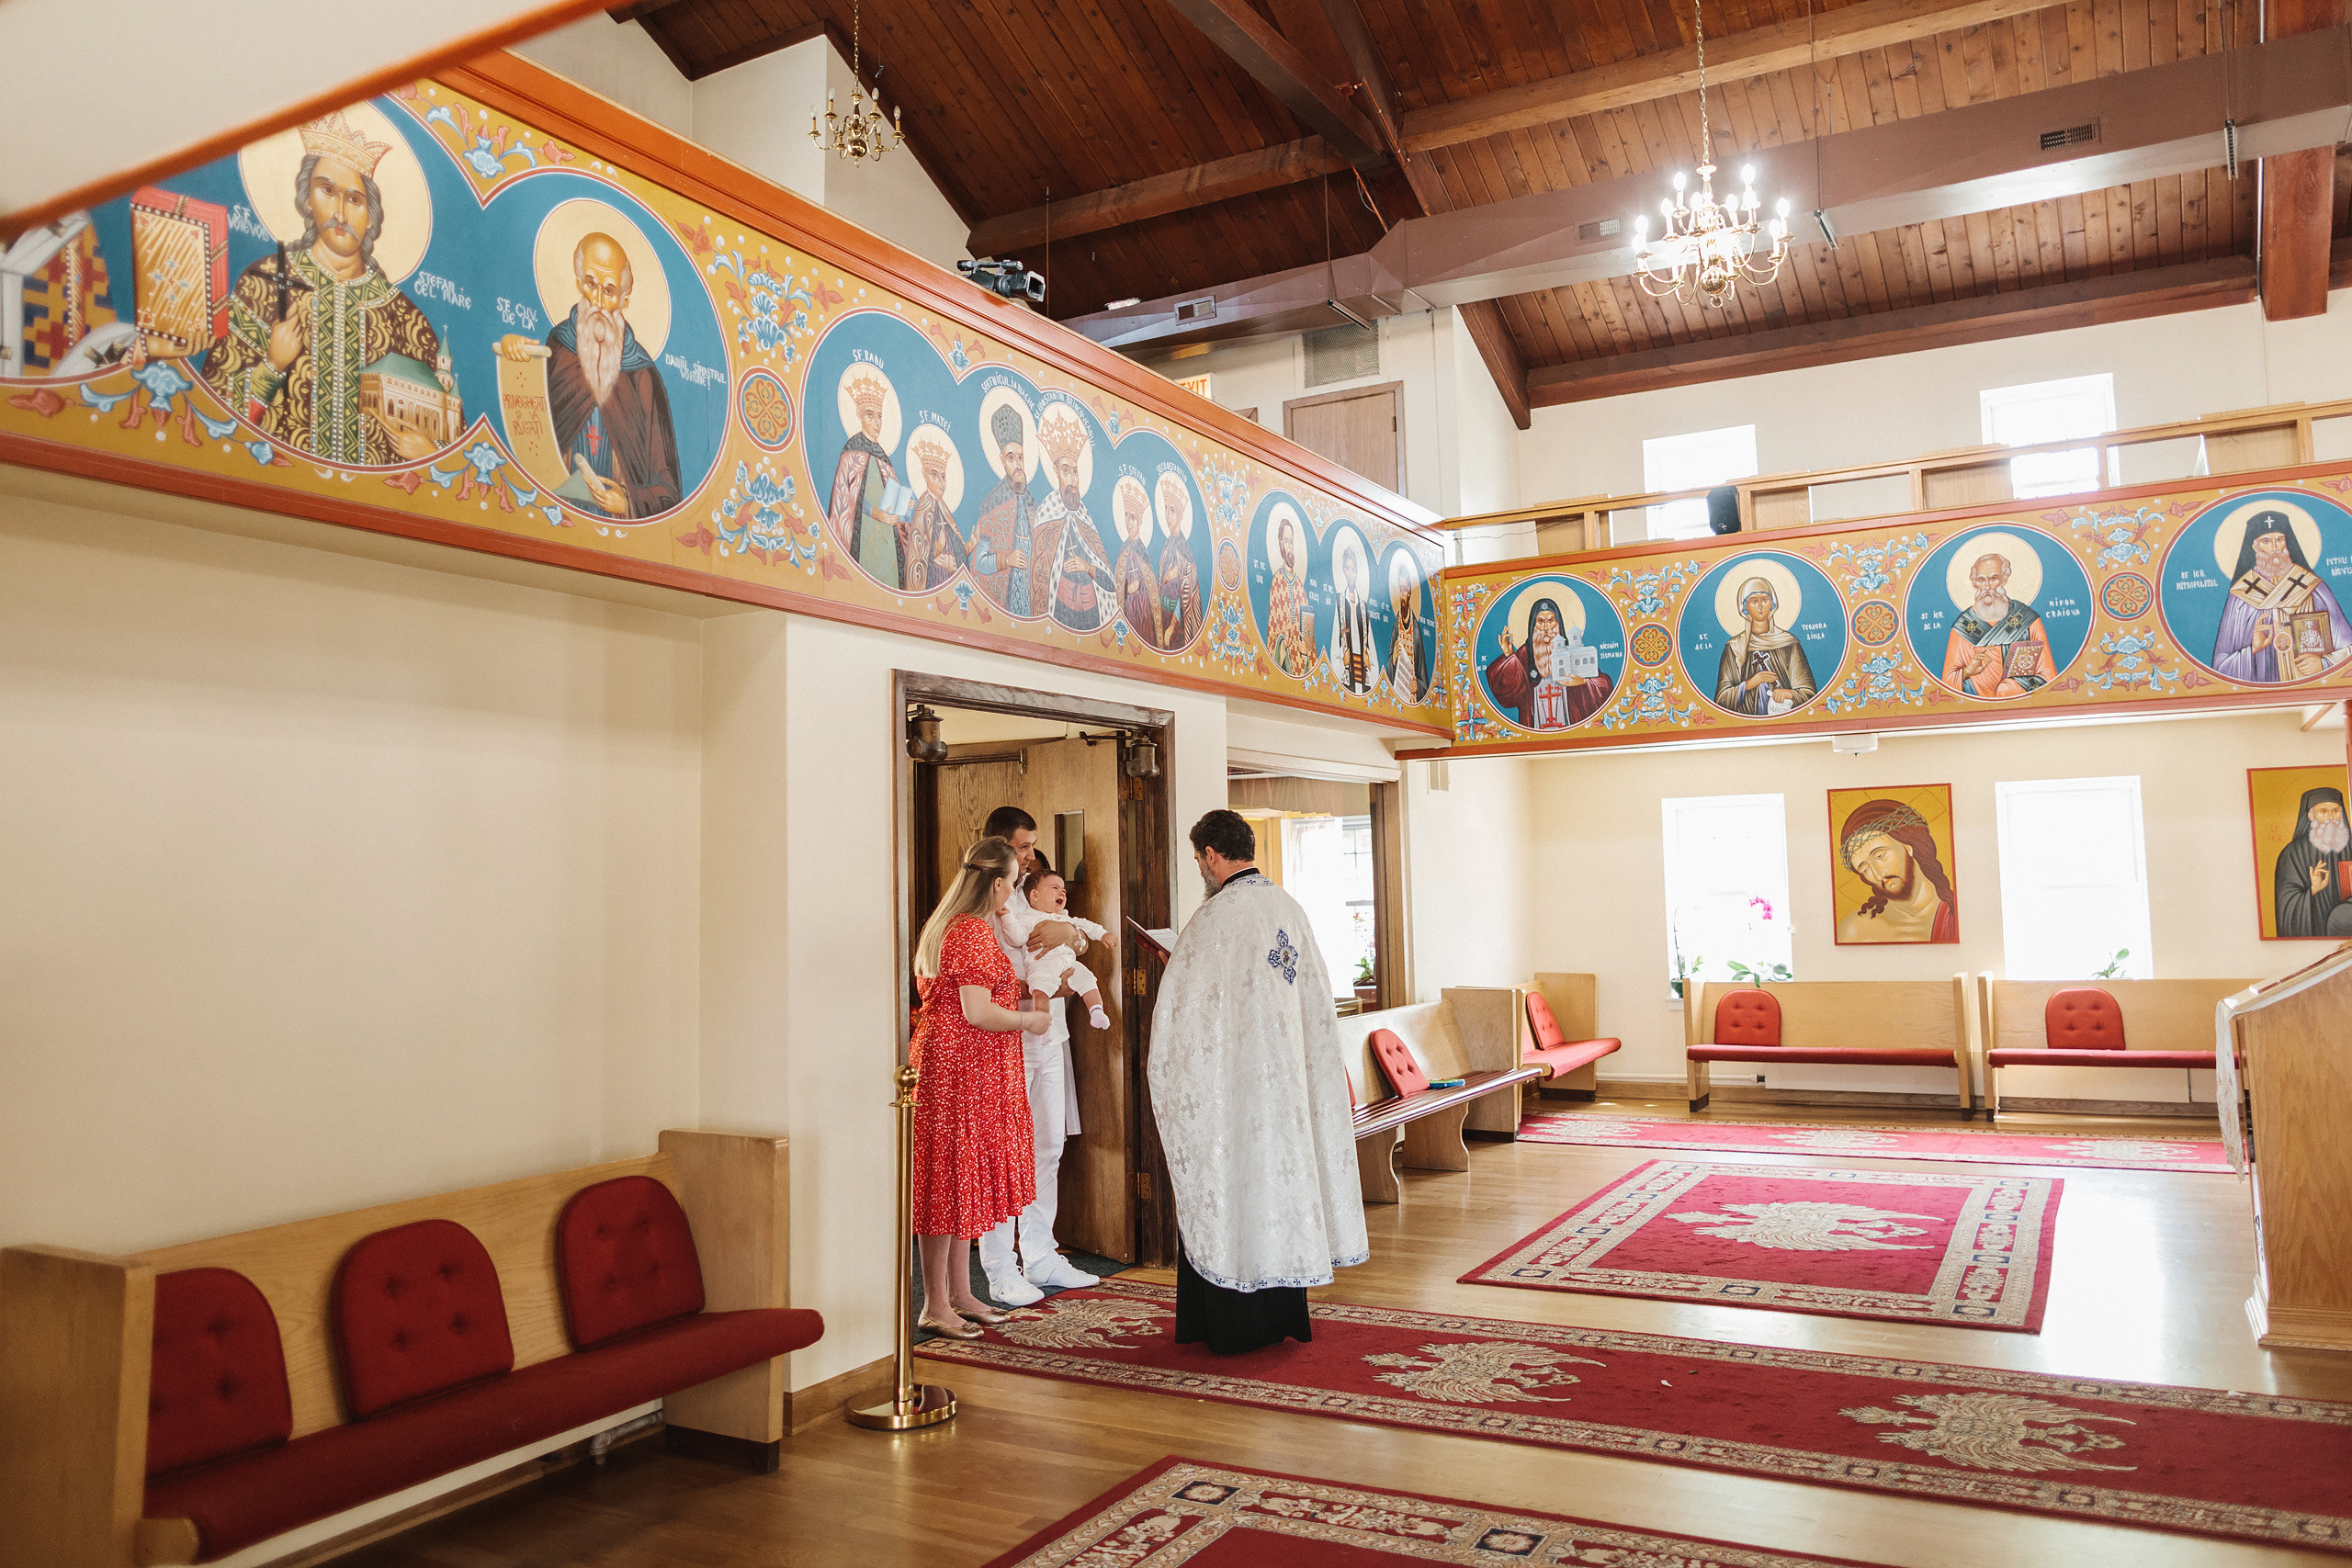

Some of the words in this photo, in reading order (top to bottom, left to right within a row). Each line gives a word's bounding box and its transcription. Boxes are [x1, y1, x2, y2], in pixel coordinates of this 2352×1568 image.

[2049, 597, 2075, 607] NIFON
[2045, 607, 2081, 619] CRAIOVA
[1801, 622, 1827, 631] TEODORA
